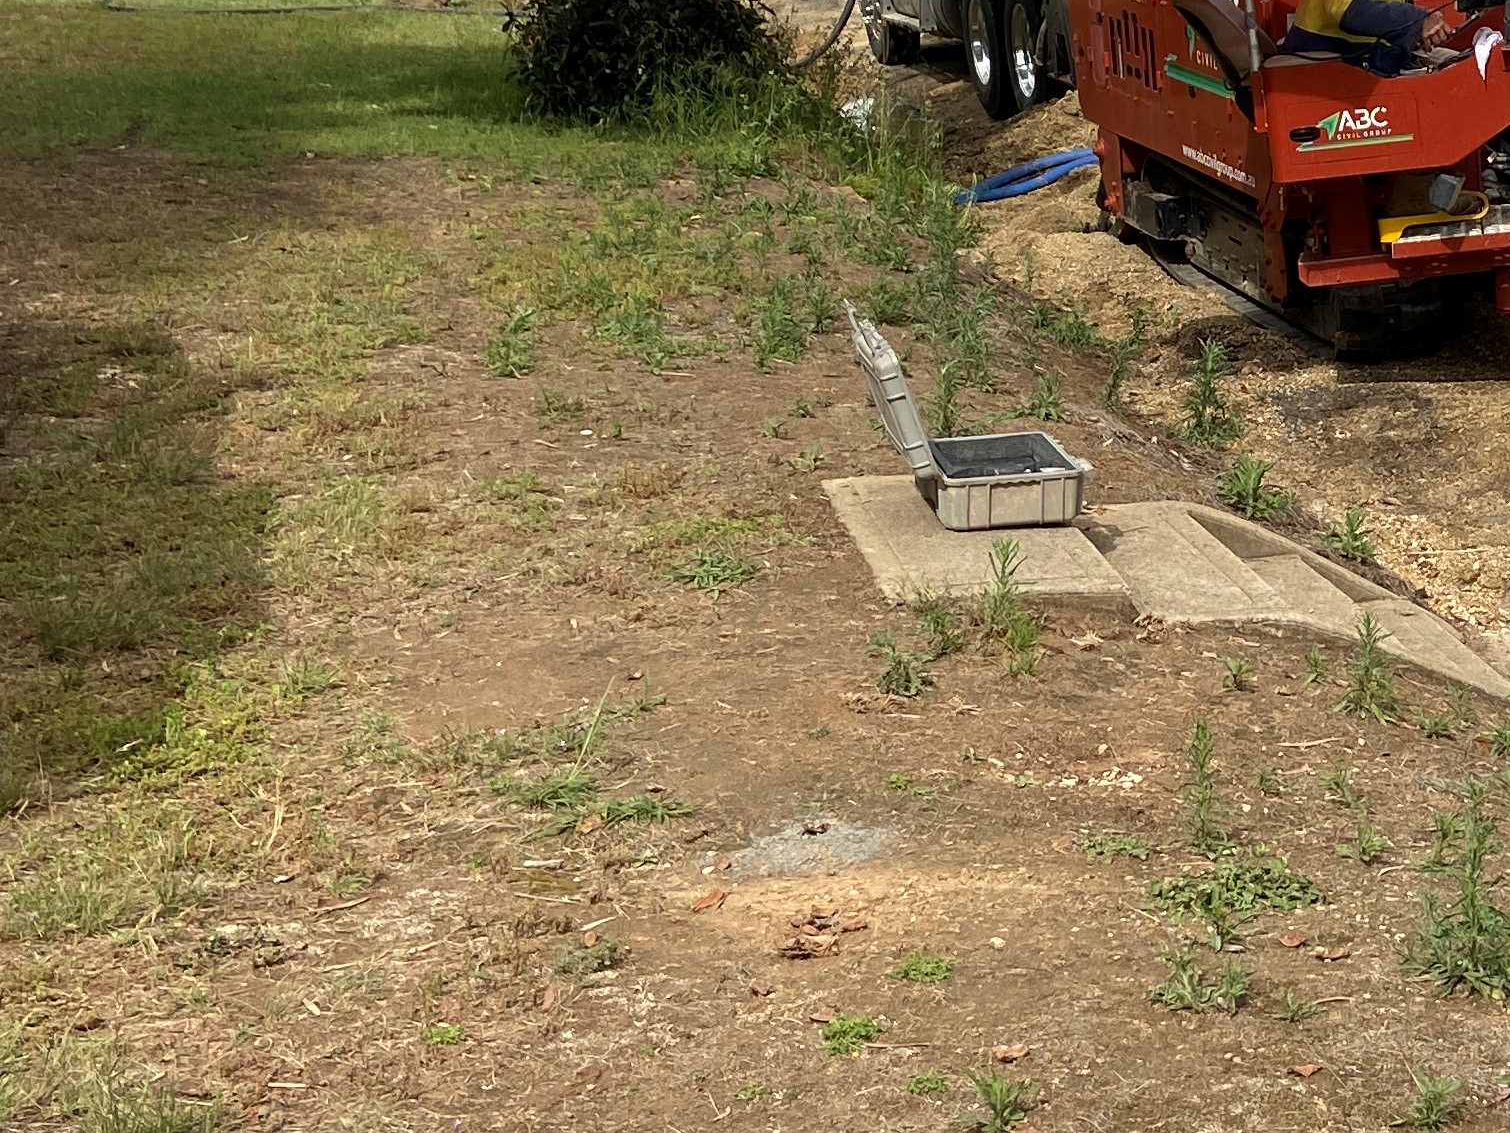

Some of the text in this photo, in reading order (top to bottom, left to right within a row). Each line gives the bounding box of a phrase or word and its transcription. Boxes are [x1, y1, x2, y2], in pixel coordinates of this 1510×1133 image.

[1196, 49, 1218, 71] CIVIL
[1338, 106, 1389, 132] ABC
[1336, 128, 1392, 140] CIVIL GROUP
